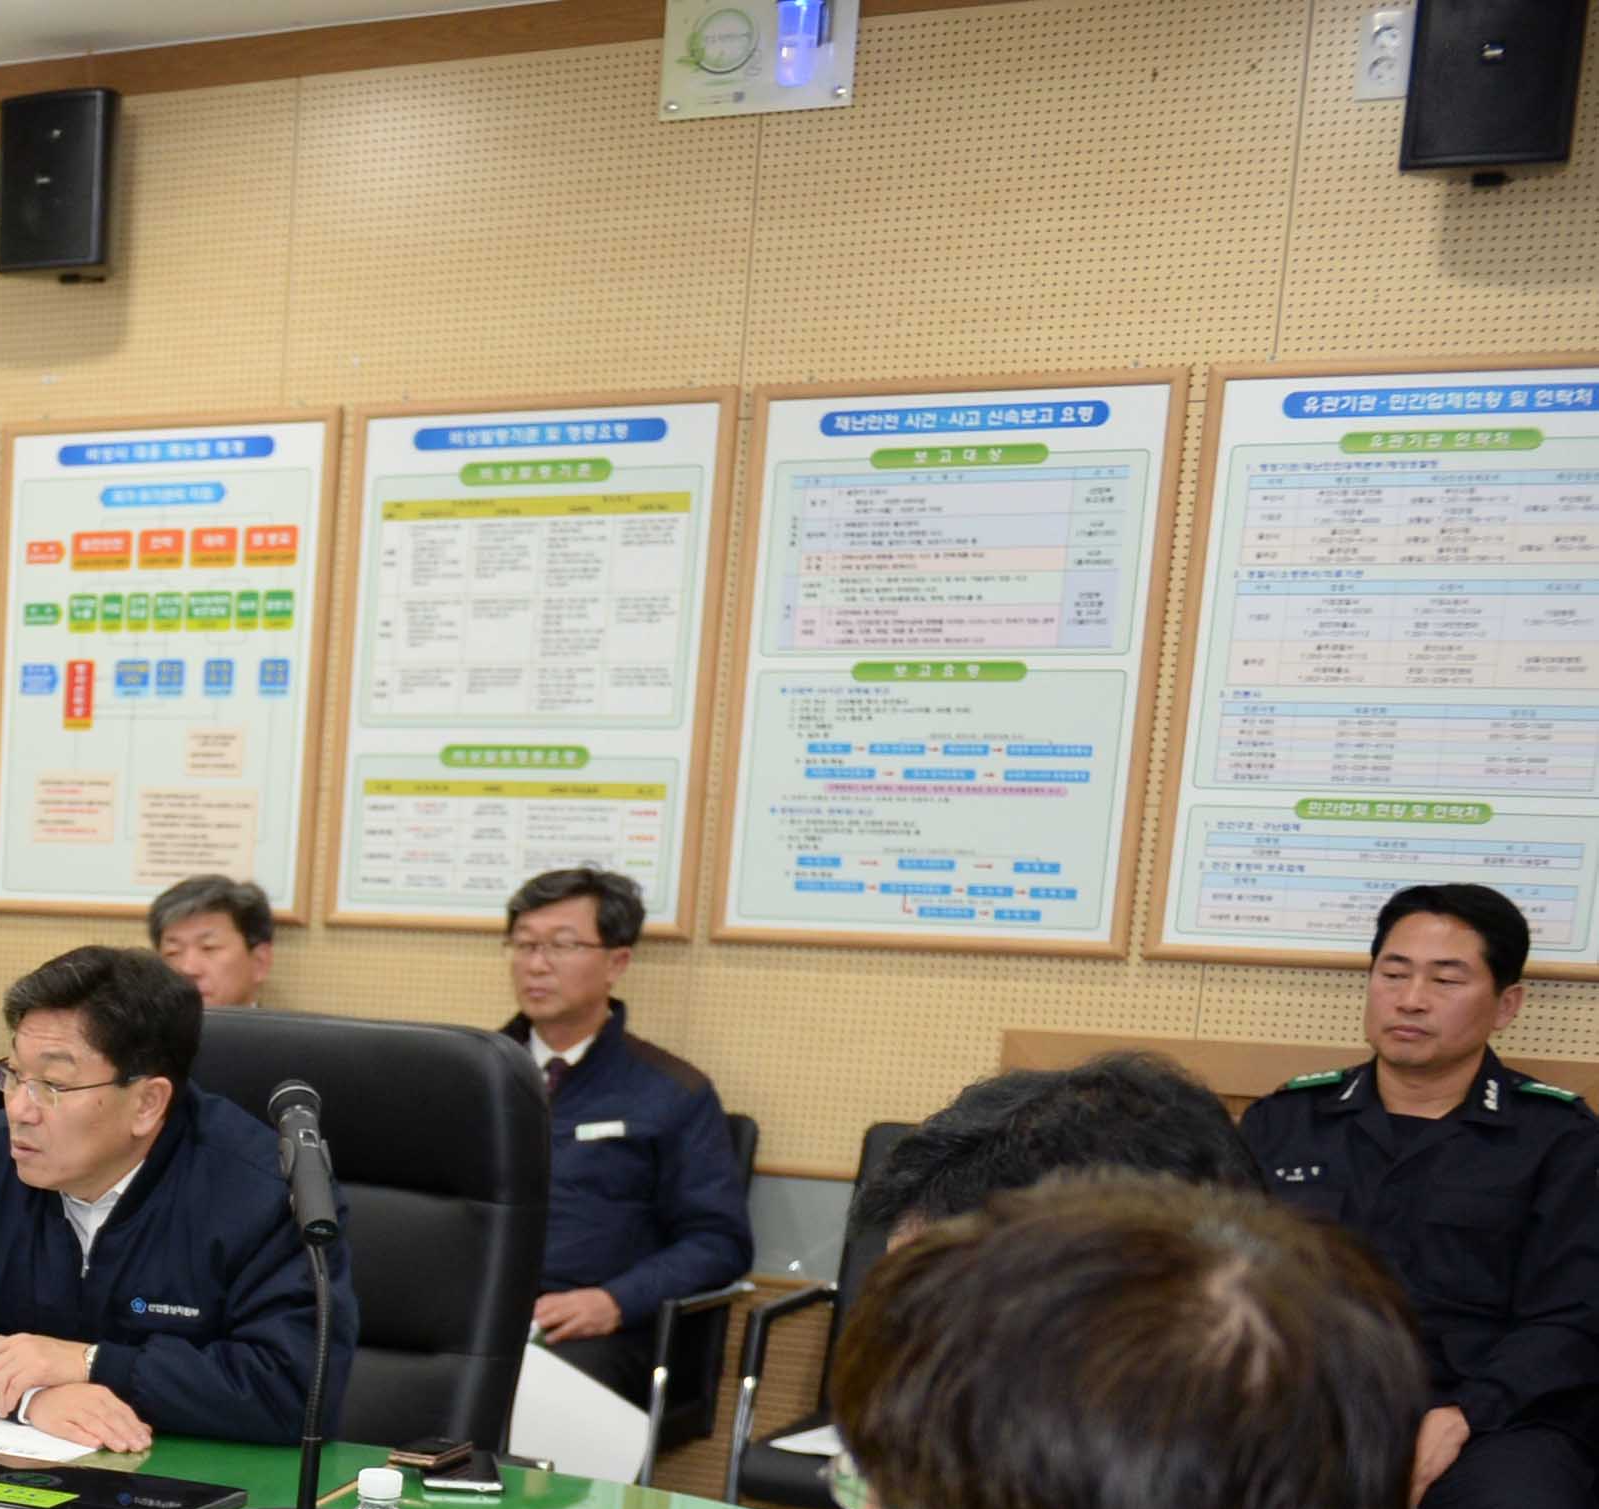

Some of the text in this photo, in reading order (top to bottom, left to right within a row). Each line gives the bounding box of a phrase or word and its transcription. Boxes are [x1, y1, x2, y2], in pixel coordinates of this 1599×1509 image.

[835, 411, 901, 433] 재난안전
[988, 407, 1054, 427] 신속보고
[1060, 405, 1094, 424] 요령
